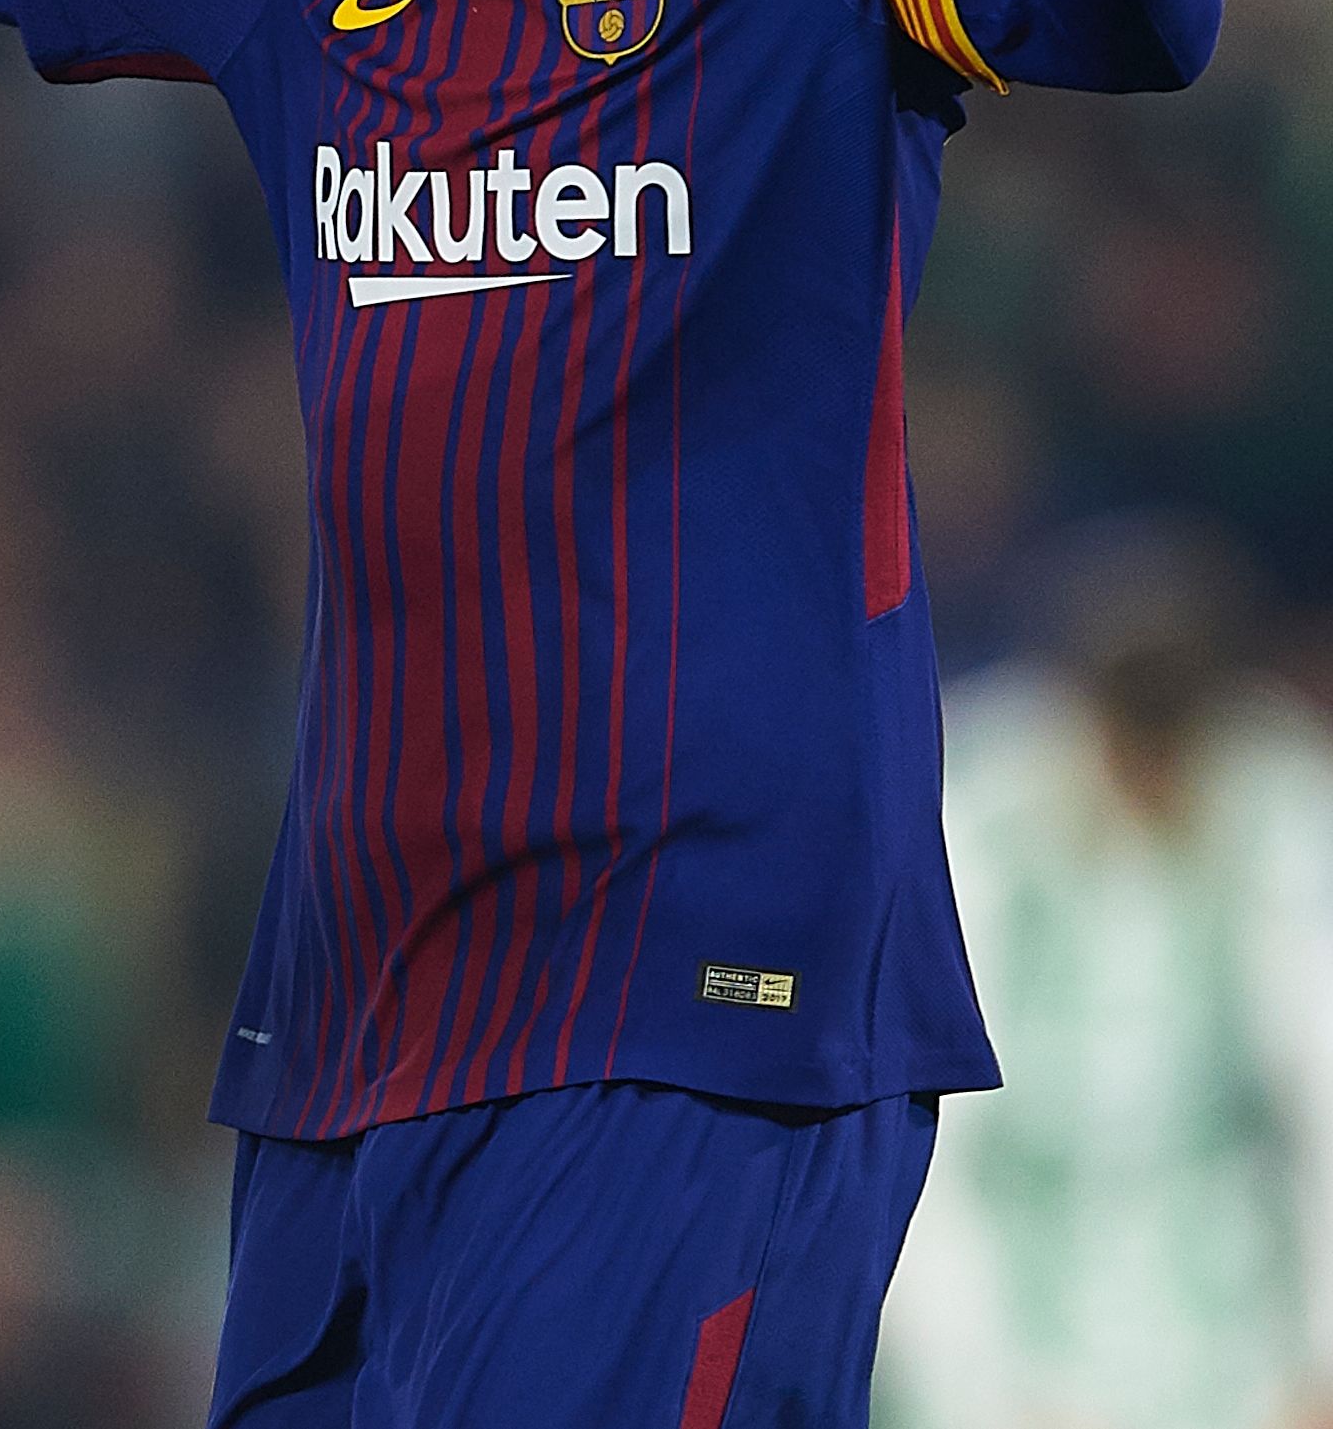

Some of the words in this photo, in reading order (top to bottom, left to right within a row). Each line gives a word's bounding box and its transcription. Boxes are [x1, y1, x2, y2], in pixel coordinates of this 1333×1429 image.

[314, 140, 693, 264] Rakuten
[709, 970, 760, 983] AUTHENTIC
[761, 992, 788, 1003] 2017
